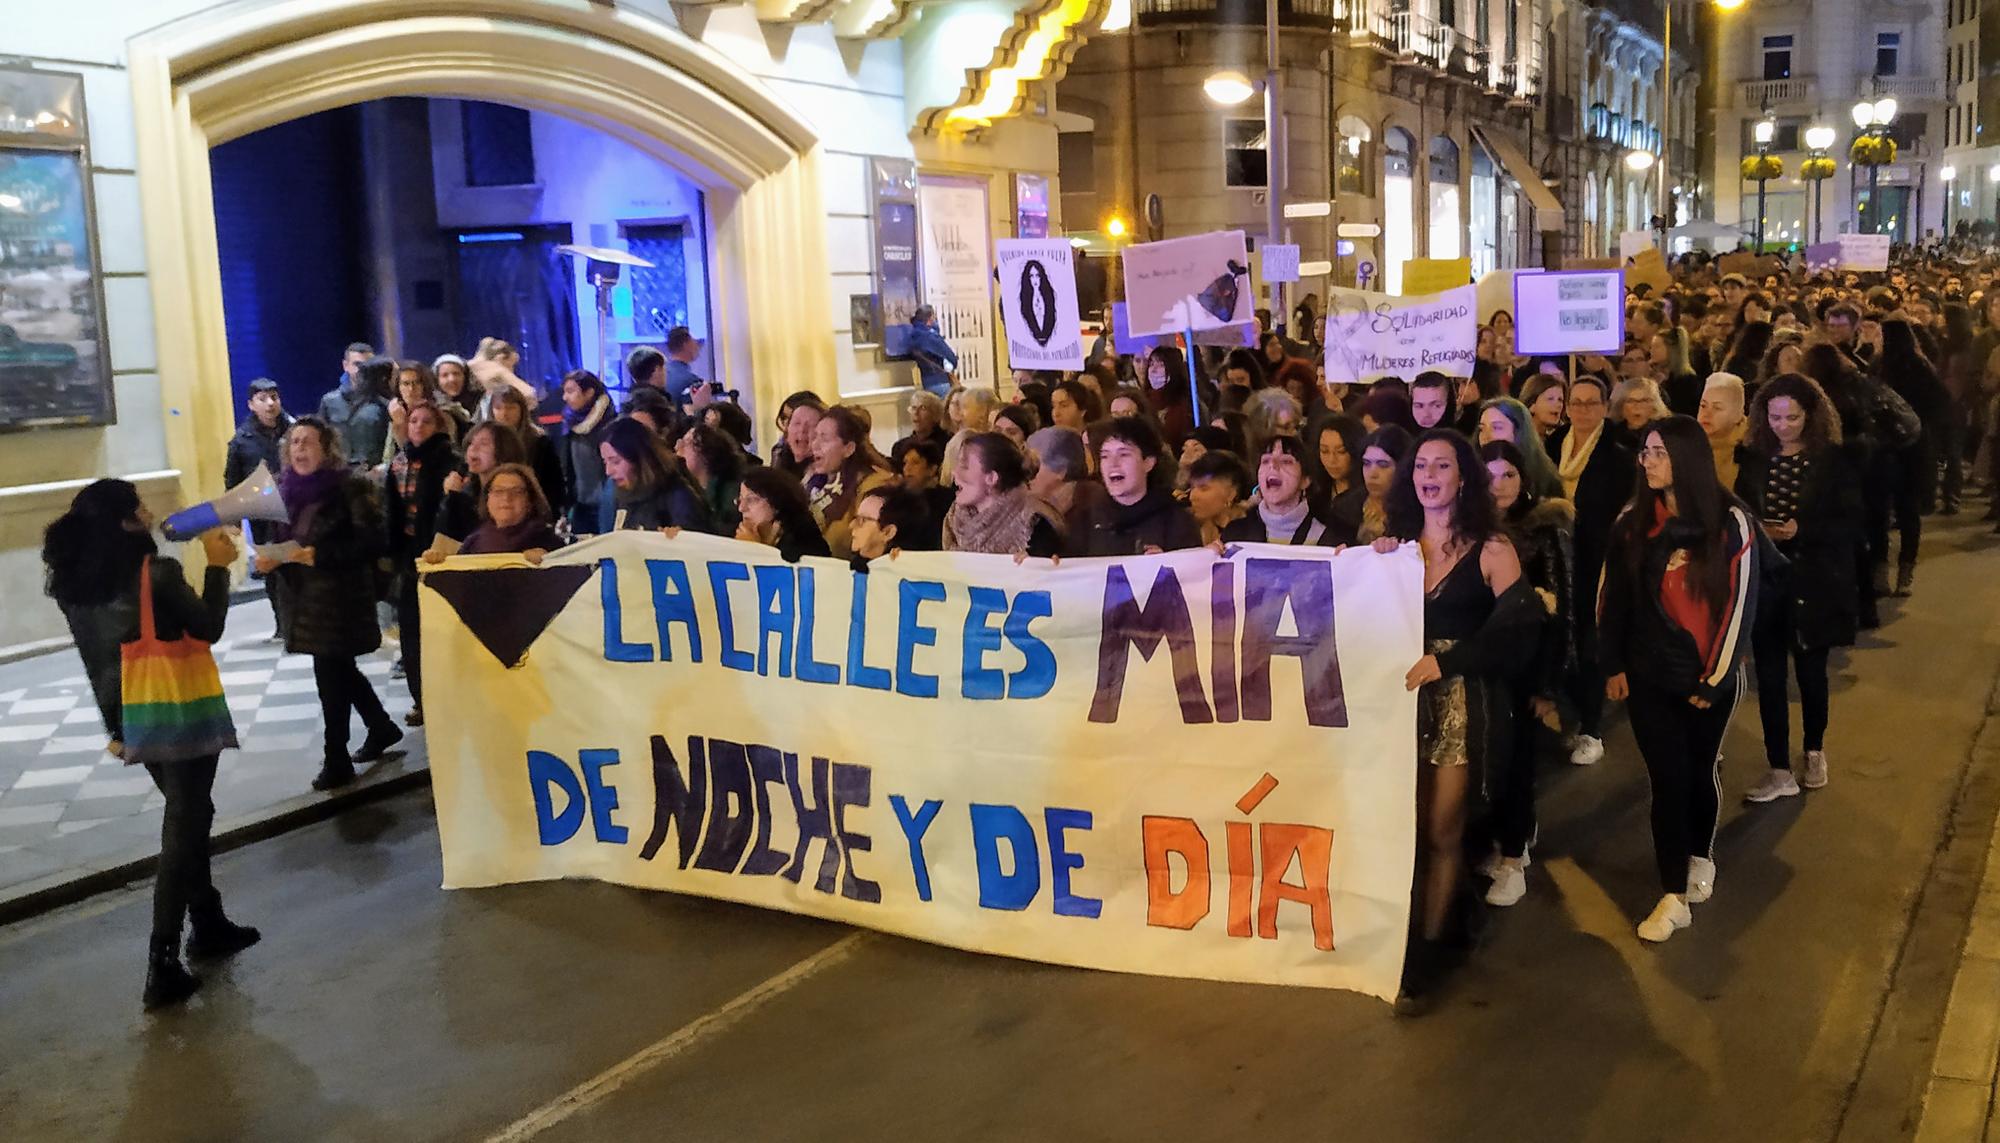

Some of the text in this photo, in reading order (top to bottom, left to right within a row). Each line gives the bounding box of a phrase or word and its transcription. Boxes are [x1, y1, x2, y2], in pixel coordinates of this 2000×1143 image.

[1361, 349, 1476, 370] MUJERES REFUGIADAS
[1371, 302, 1468, 335] SOLIDARIDAD
[598, 557, 703, 664] LA
[706, 560, 946, 699] CALLE
[961, 585, 1058, 700] ES
[526, 734, 1336, 952] DE NOCHE Y DE DÍA
